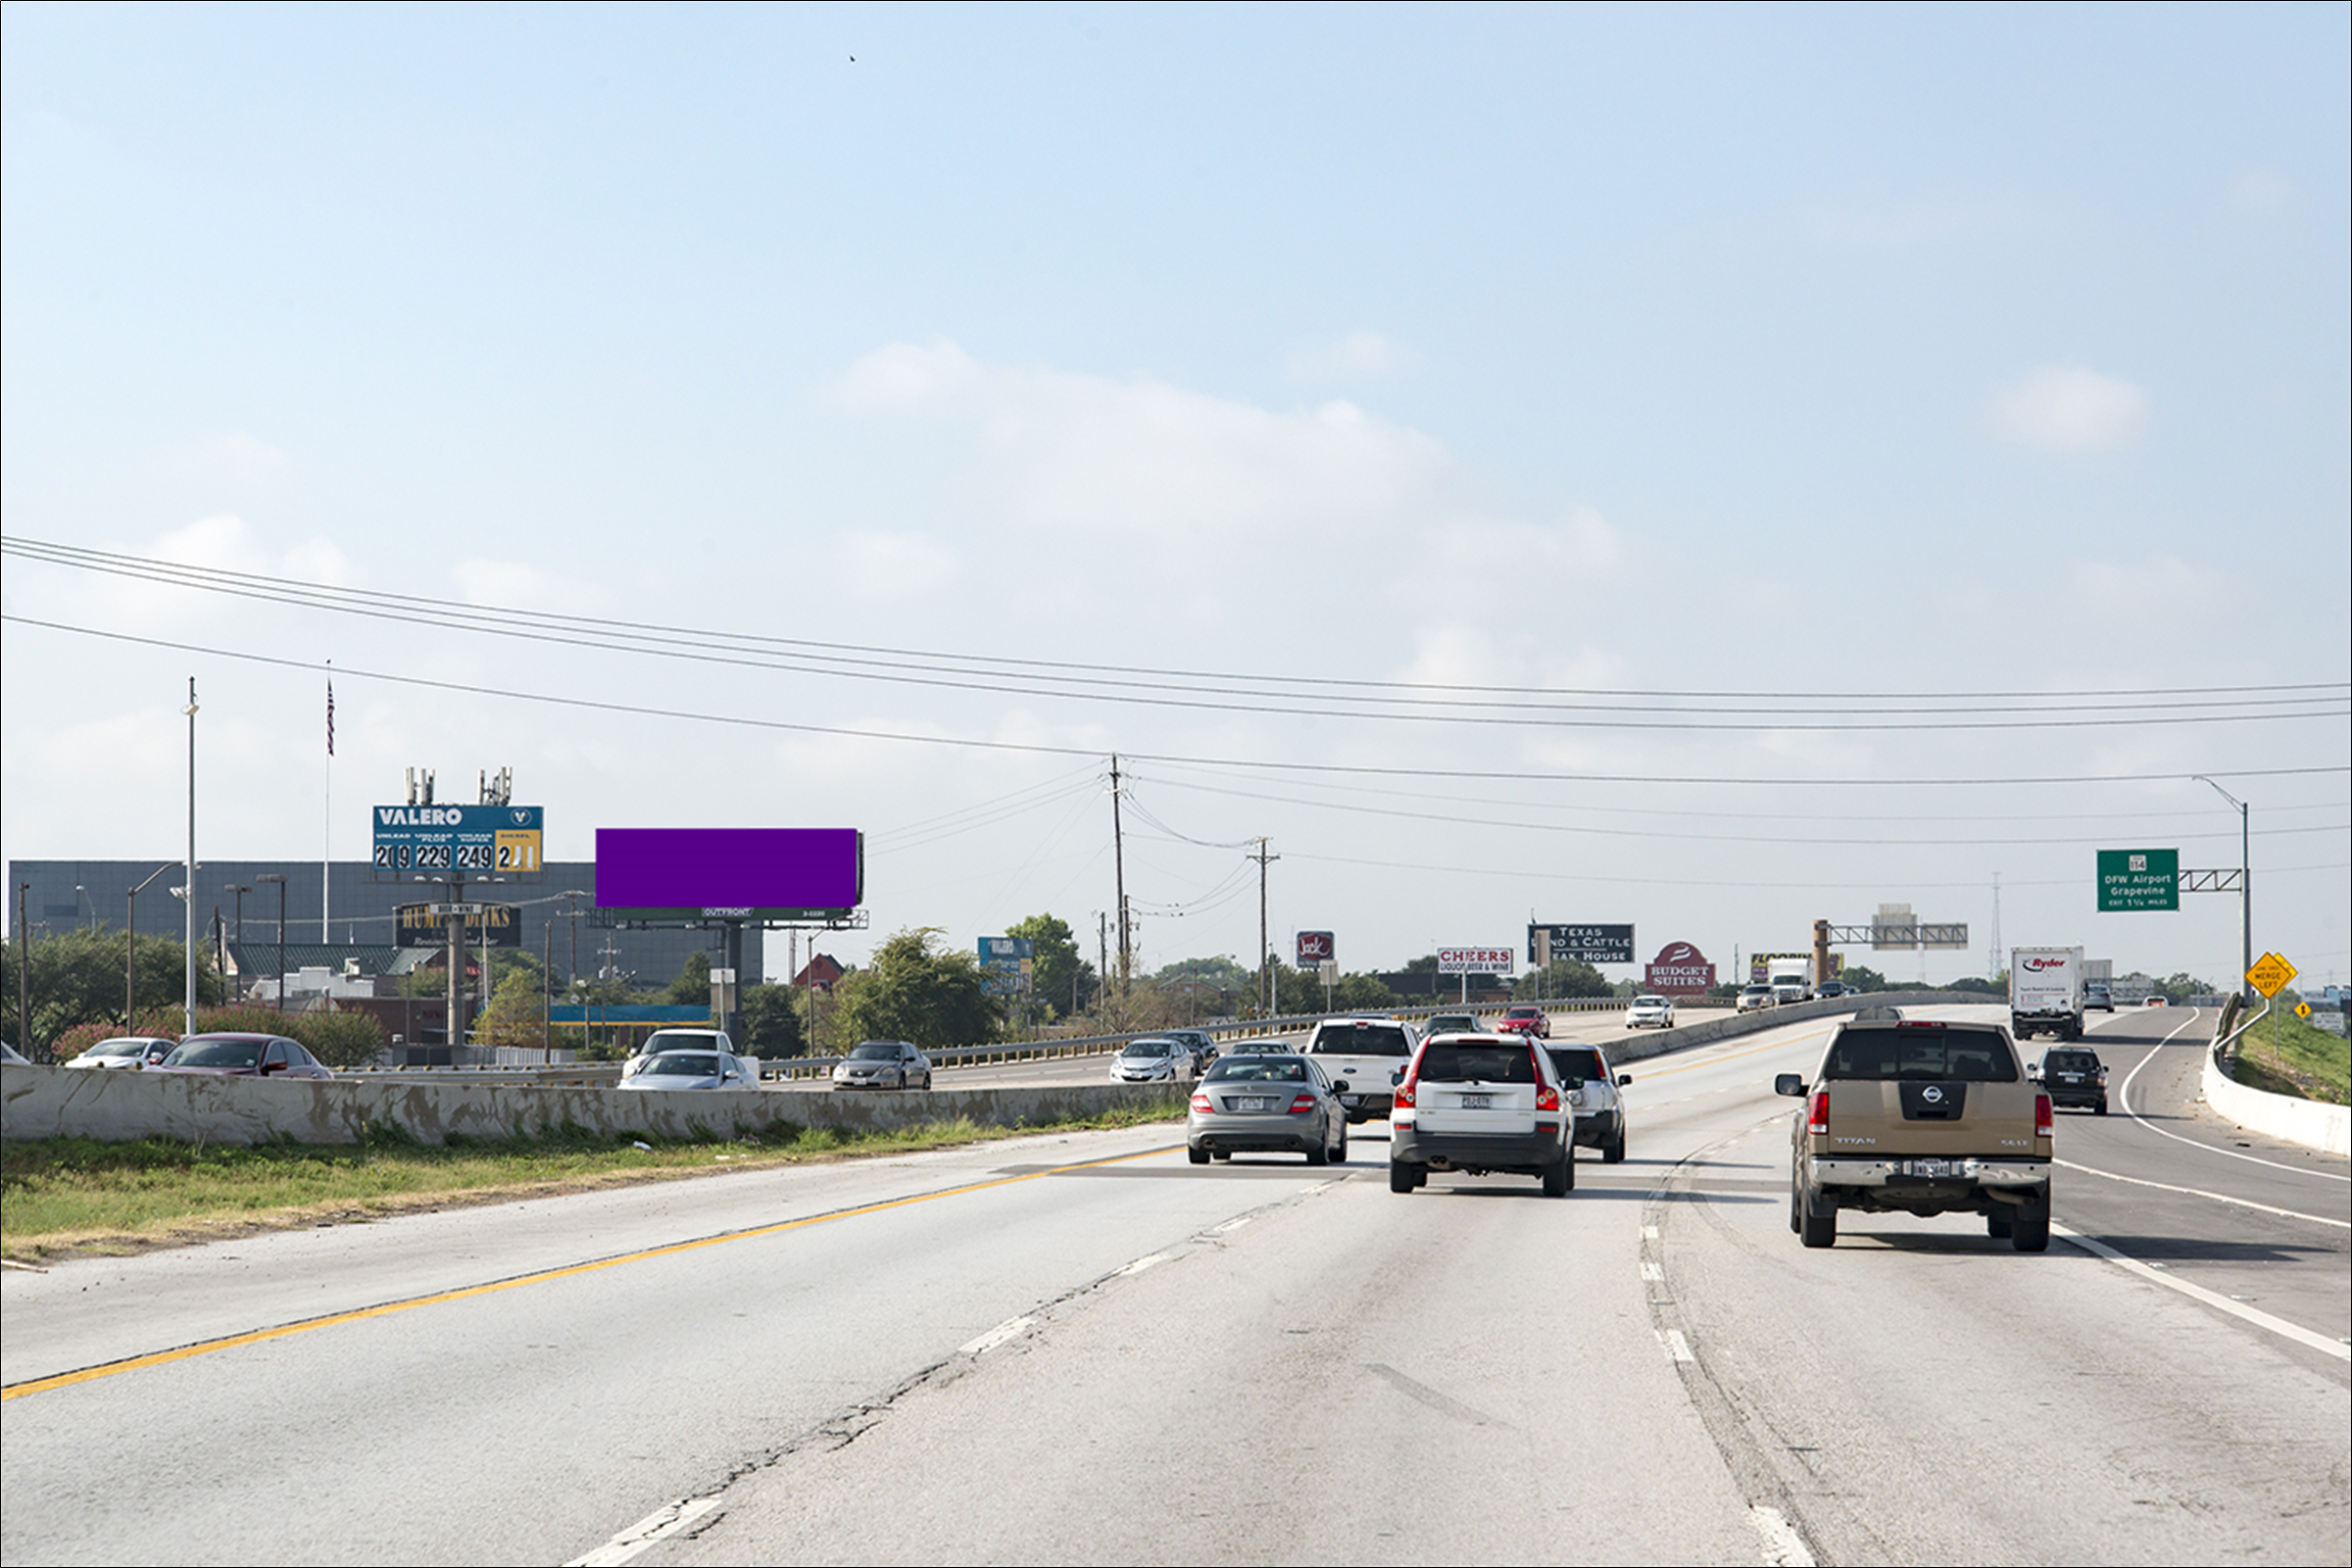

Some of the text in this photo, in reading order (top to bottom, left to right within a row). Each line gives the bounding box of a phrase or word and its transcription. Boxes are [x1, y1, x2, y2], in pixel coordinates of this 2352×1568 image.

[378, 808, 463, 825] VALERO
[416, 846, 451, 867] 229
[458, 846, 492, 867] 249
[2105, 874, 2171, 885] DFW Airport
[2110, 887, 2166, 897] Grapevine
[1559, 927, 1602, 936] TEXAS
[1298, 937, 1331, 956] Jack
[1531, 938, 1566, 947] LND
[1582, 938, 1631, 947] CATTLE
[1440, 951, 1509, 962] CHEERS
[1583, 952, 1626, 960] HOUSE
[2033, 958, 2066, 969] Ryder
[1651, 966, 1709, 976] BUDGET
[1653, 976, 1706, 986] SUITES
